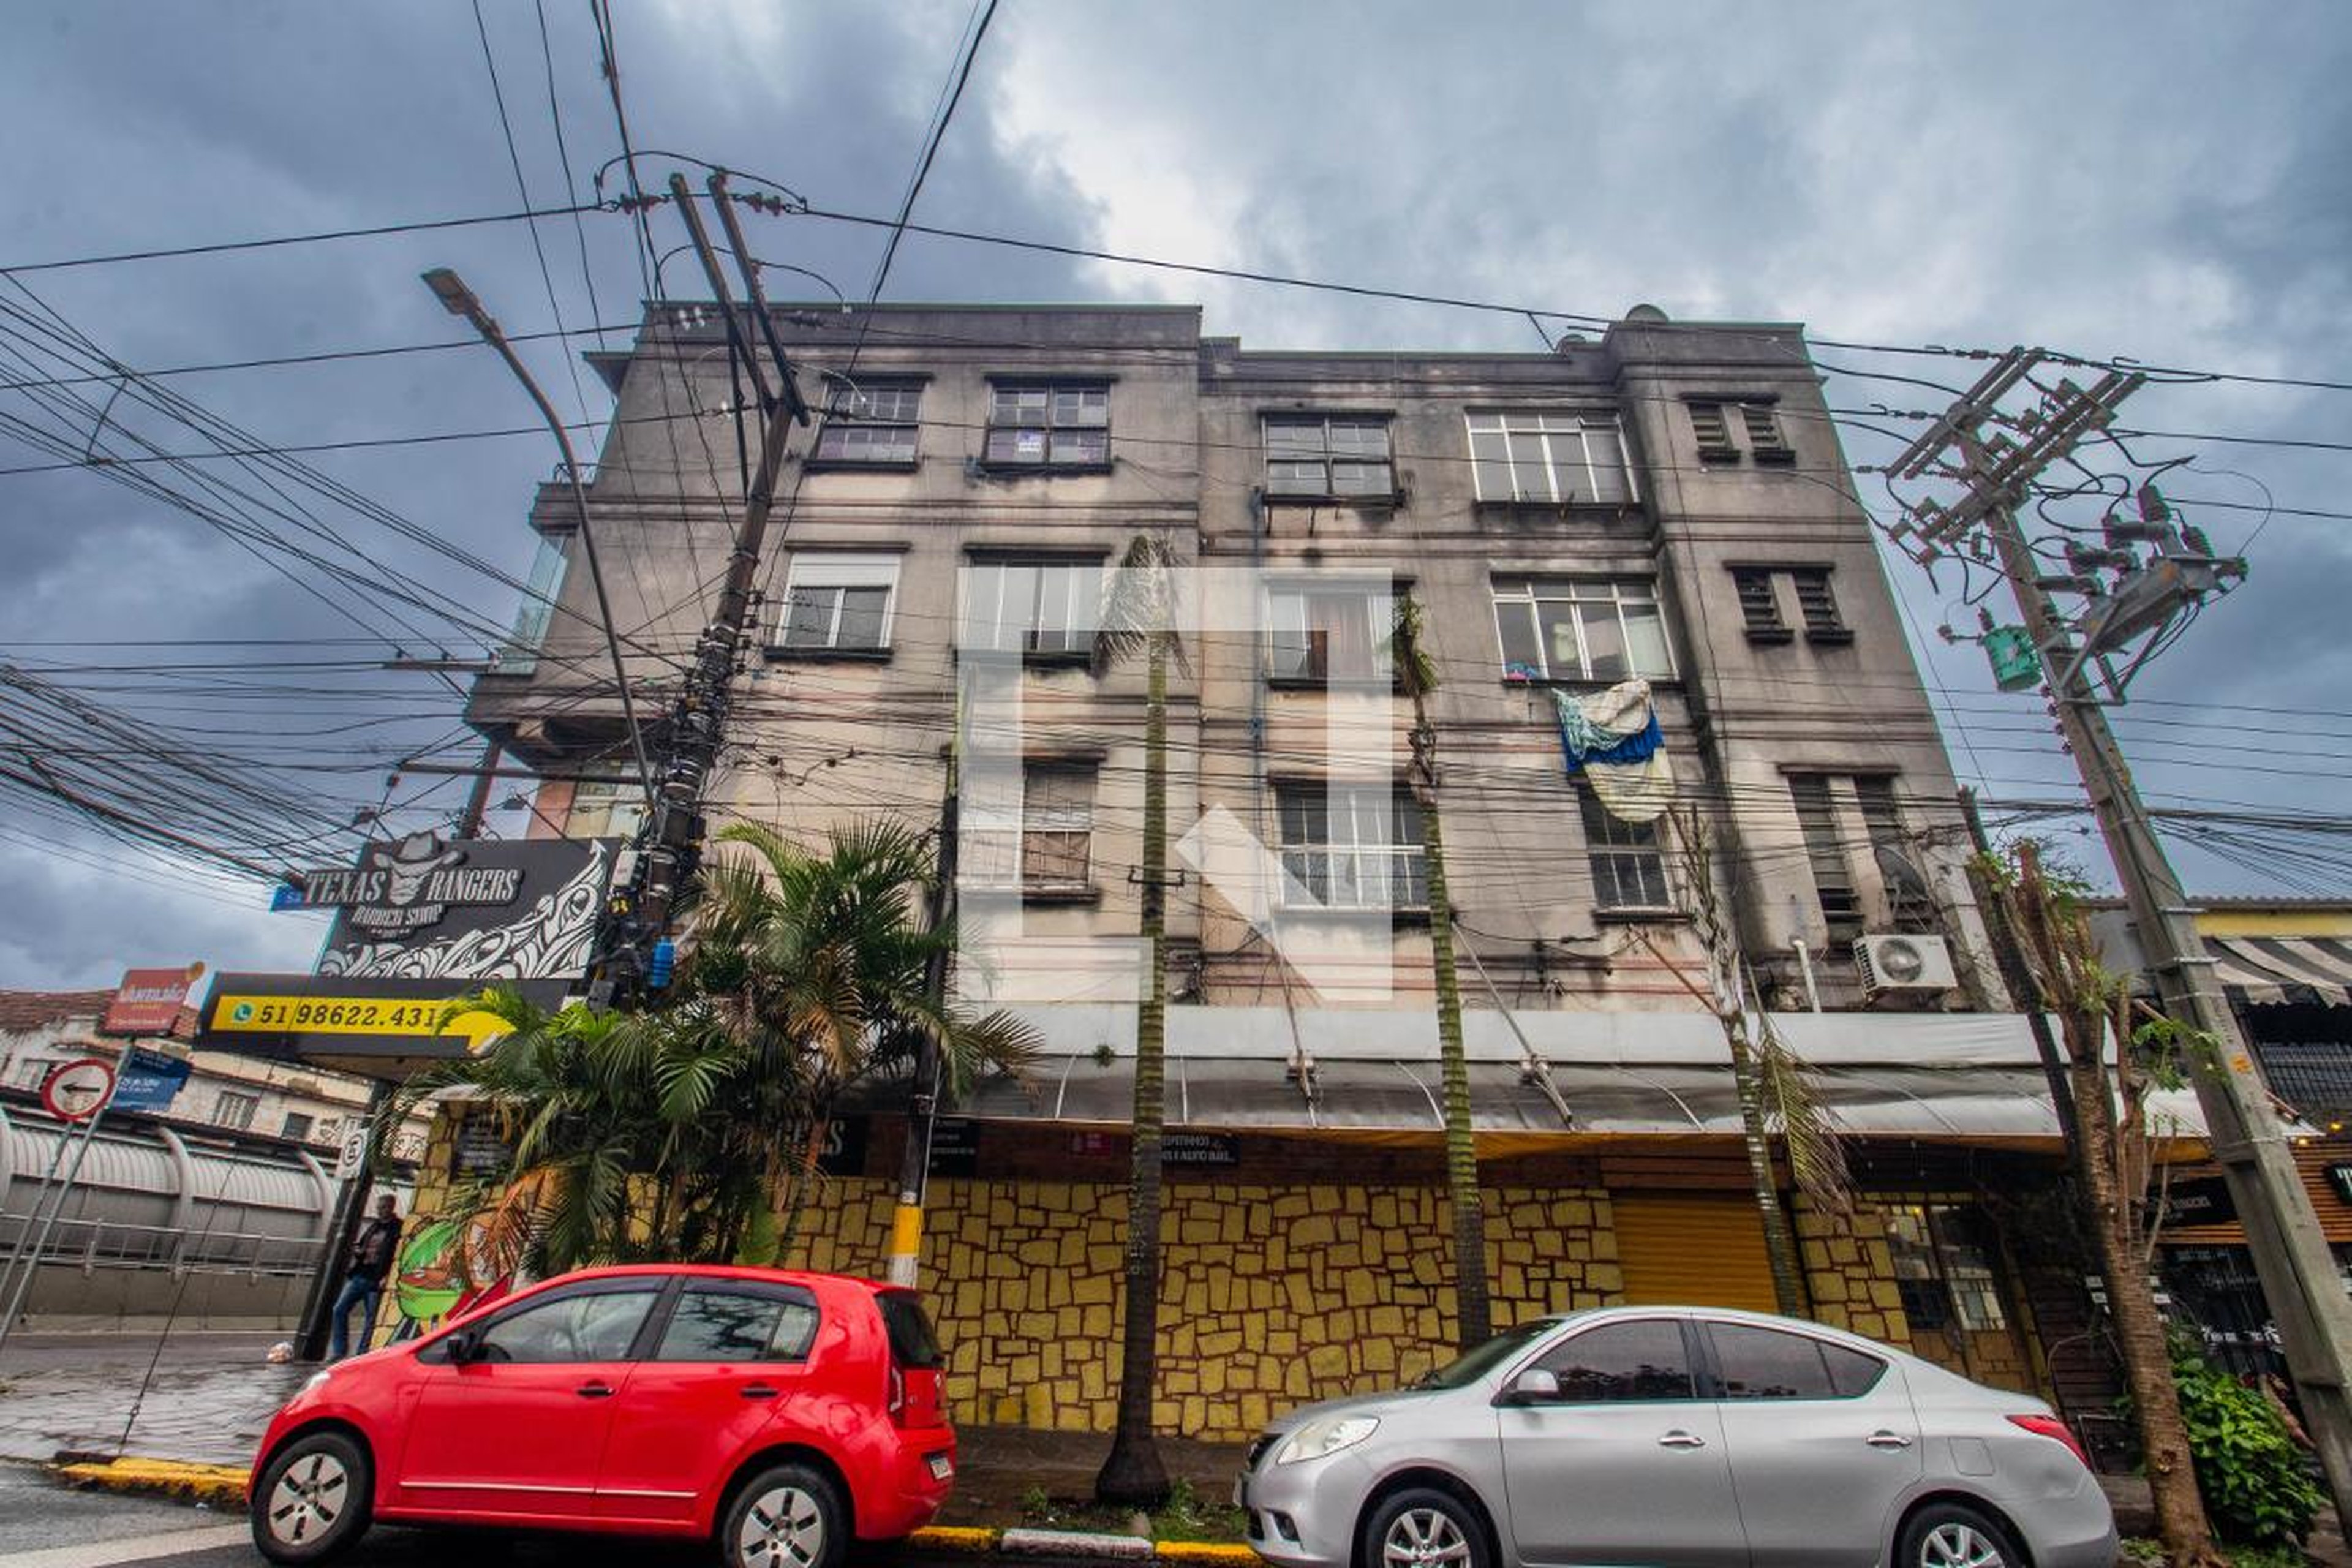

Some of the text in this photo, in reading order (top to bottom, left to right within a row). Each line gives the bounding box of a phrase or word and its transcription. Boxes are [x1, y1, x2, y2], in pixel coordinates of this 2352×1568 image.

[306, 869, 518, 903] TEXAS RANGERS
[351, 903, 442, 927] BARBER SHOP
[260, 1005, 436, 1027] 51 98622.431
